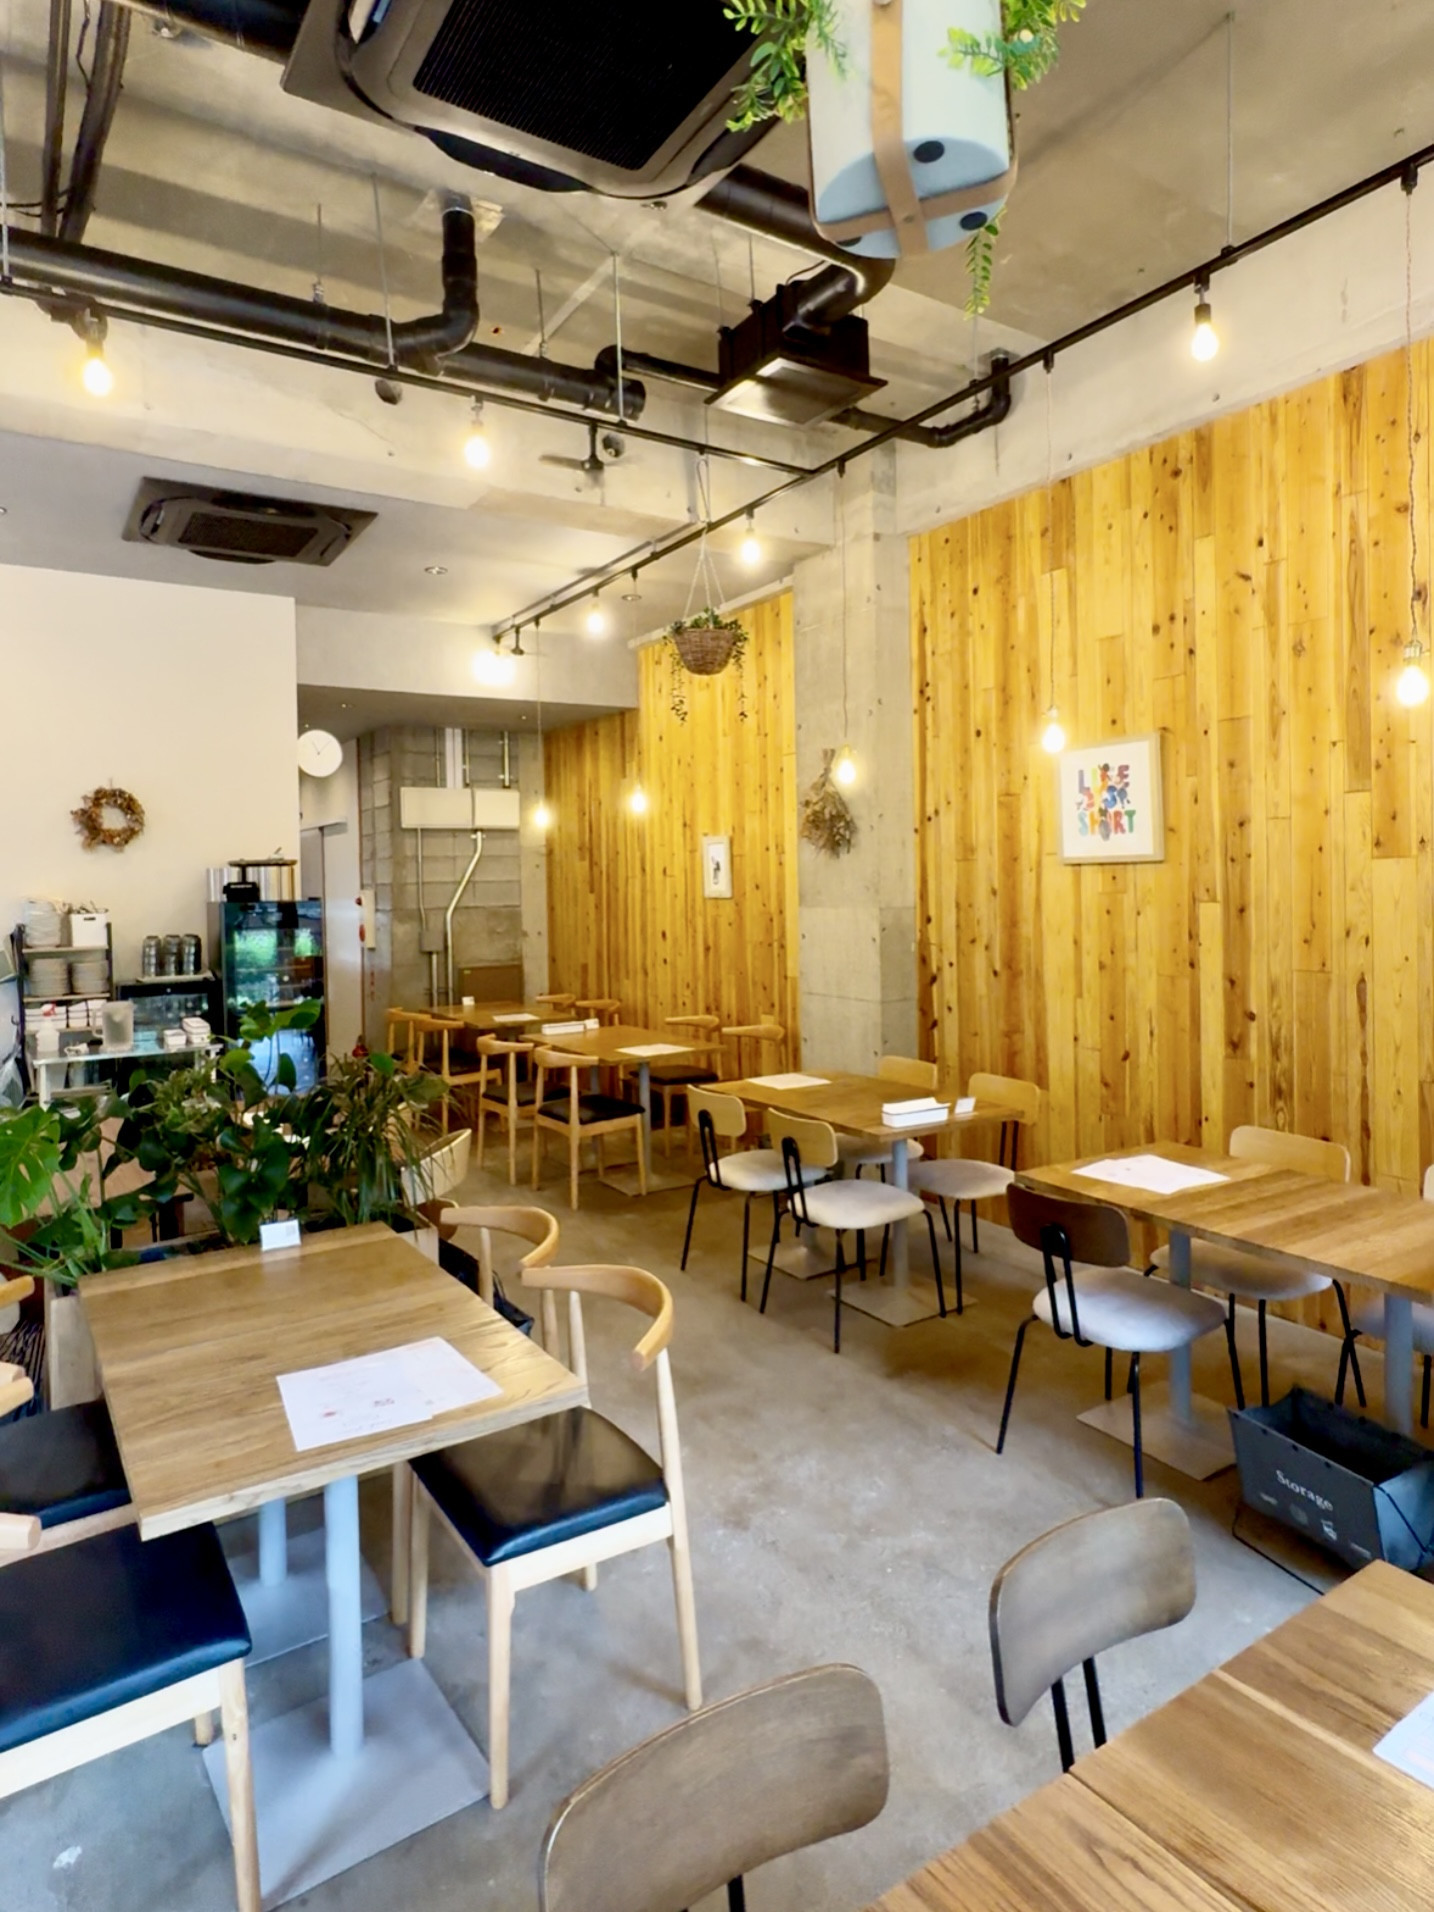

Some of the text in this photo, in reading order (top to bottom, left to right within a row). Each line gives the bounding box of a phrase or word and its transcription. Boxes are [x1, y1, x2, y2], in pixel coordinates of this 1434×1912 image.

[1078, 764, 1130, 793] LIE
[1078, 809, 1136, 836] SHRT
[1276, 1469, 1334, 1511] Storage
